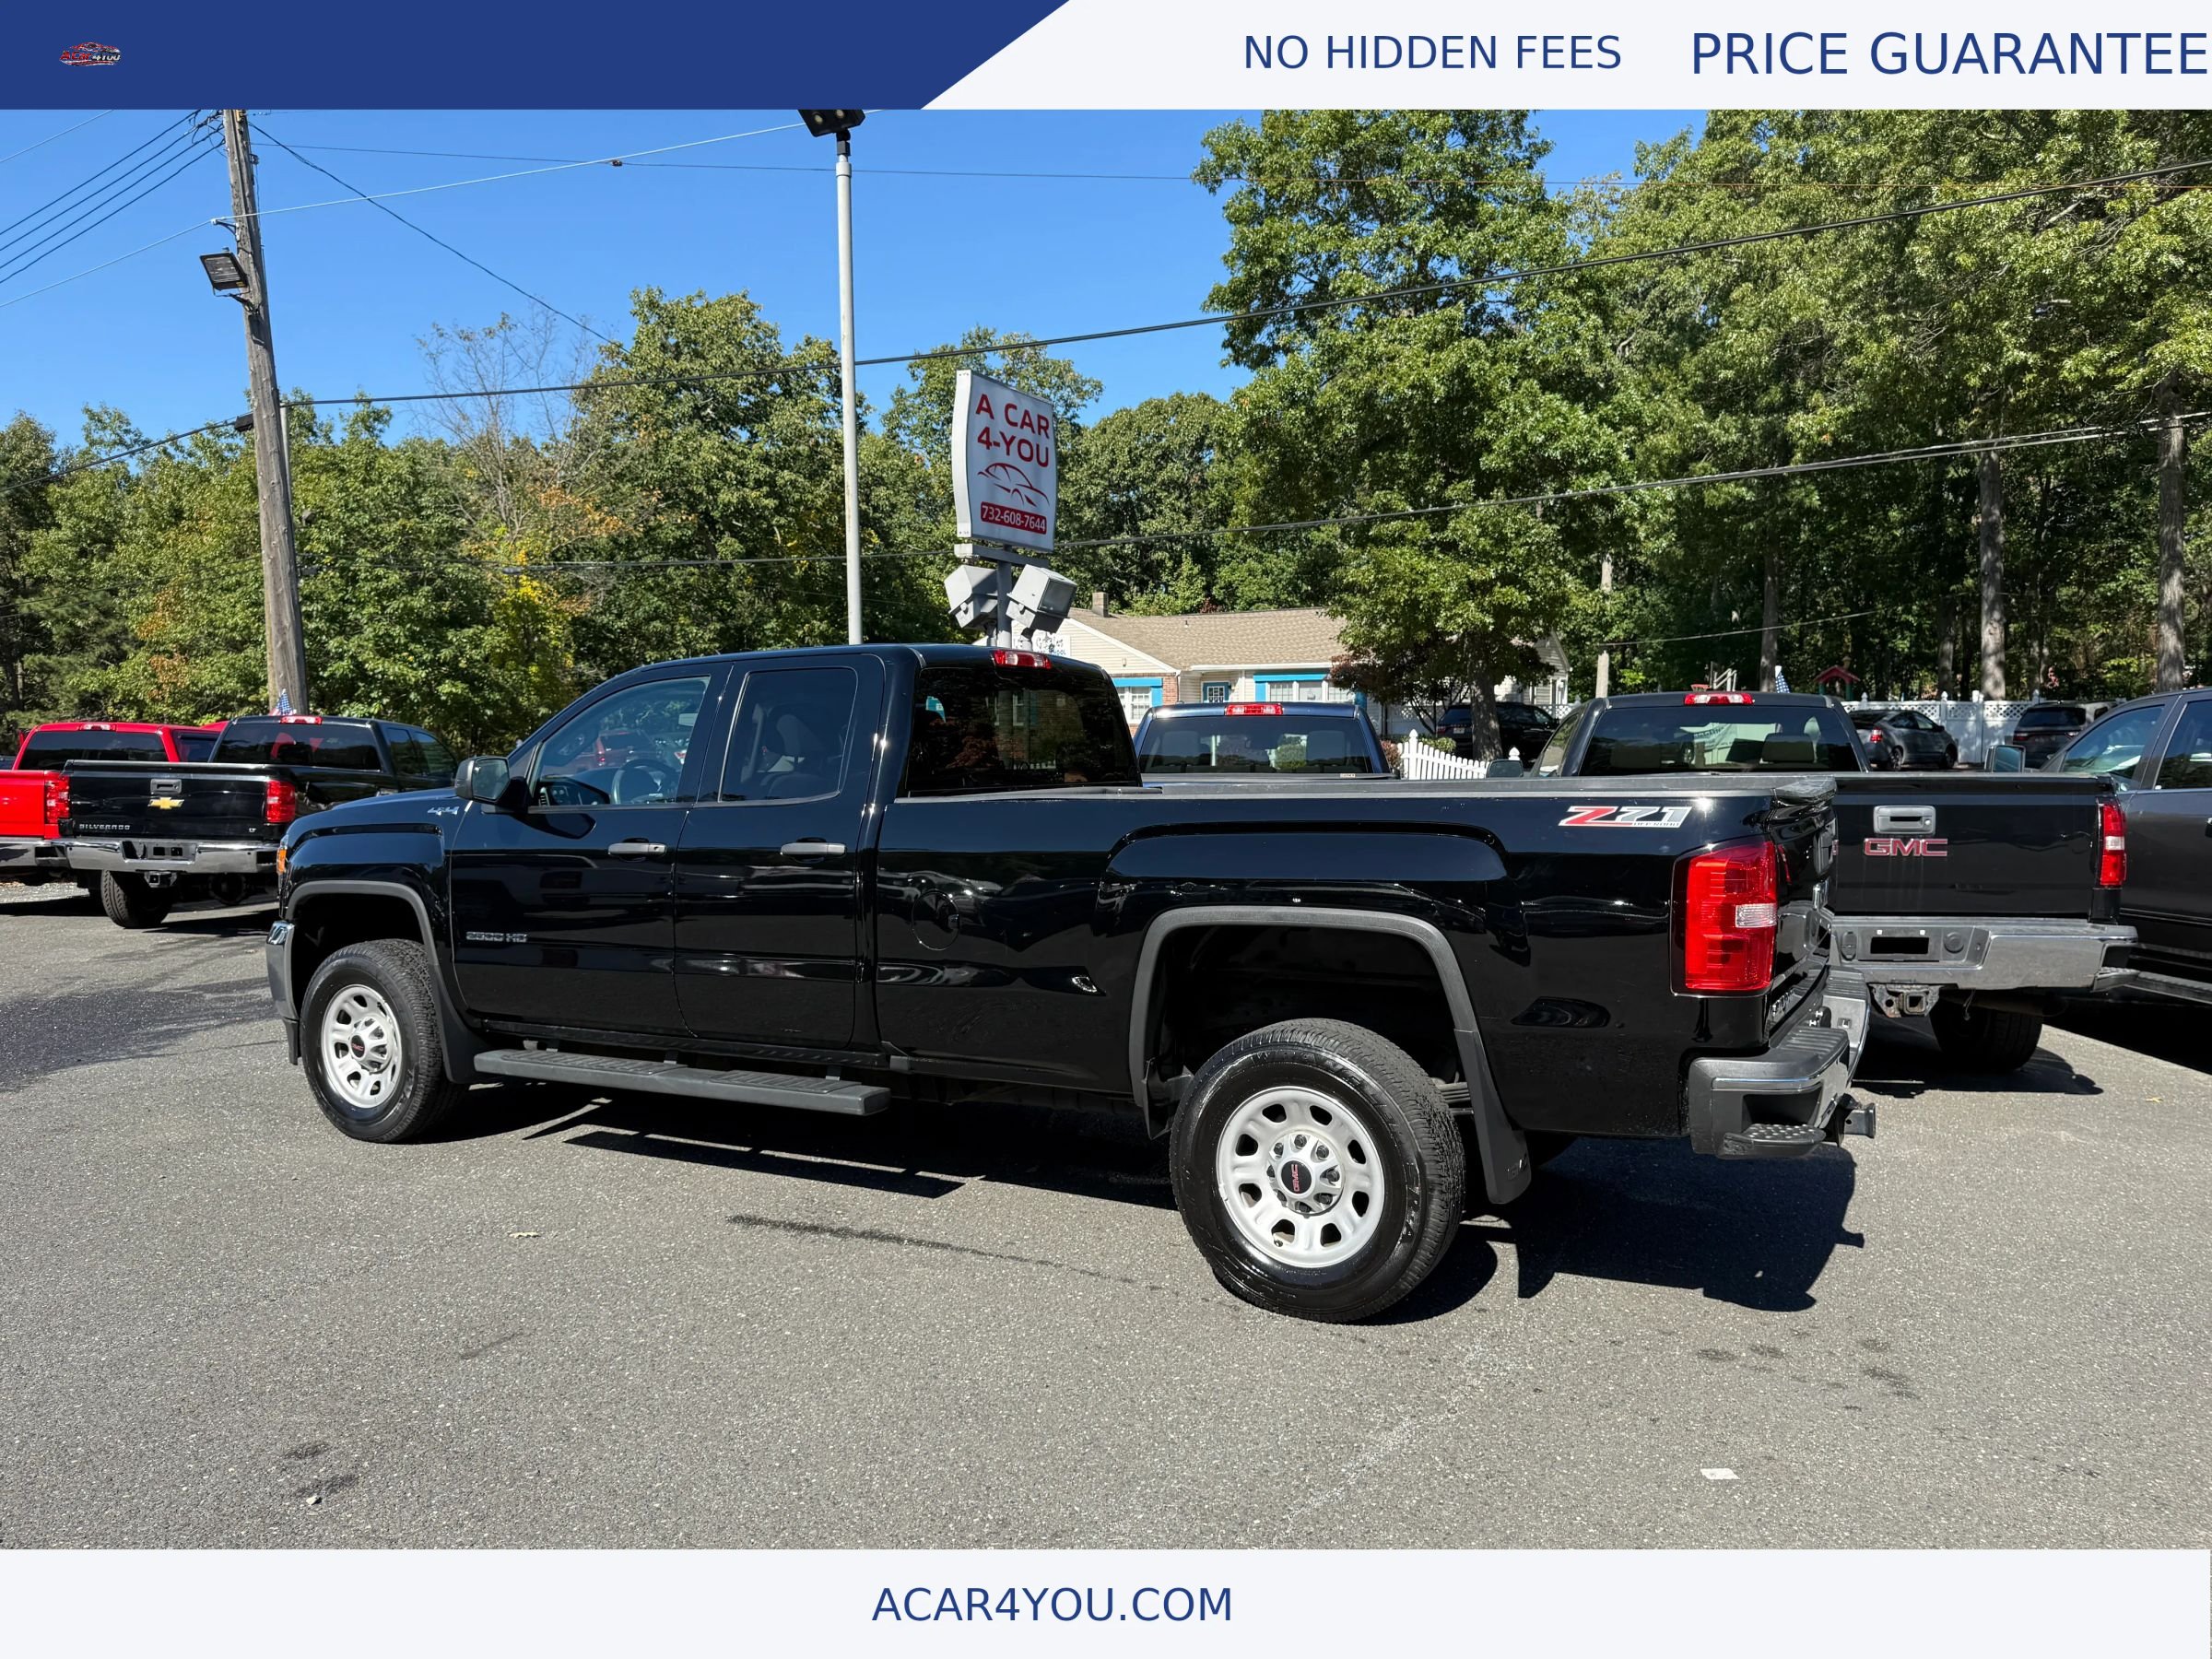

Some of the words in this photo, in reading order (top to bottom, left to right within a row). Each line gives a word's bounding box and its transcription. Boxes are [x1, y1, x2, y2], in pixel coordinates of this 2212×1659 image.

[975, 393, 994, 420] A
[1004, 403, 1050, 440] CAR
[977, 426, 1049, 468] 4-YOU
[982, 506, 1046, 532] 732-608-7644
[1558, 806, 1693, 829] Z71
[1864, 837, 1948, 857] GMC
[1290, 1163, 1300, 1193] GMC
